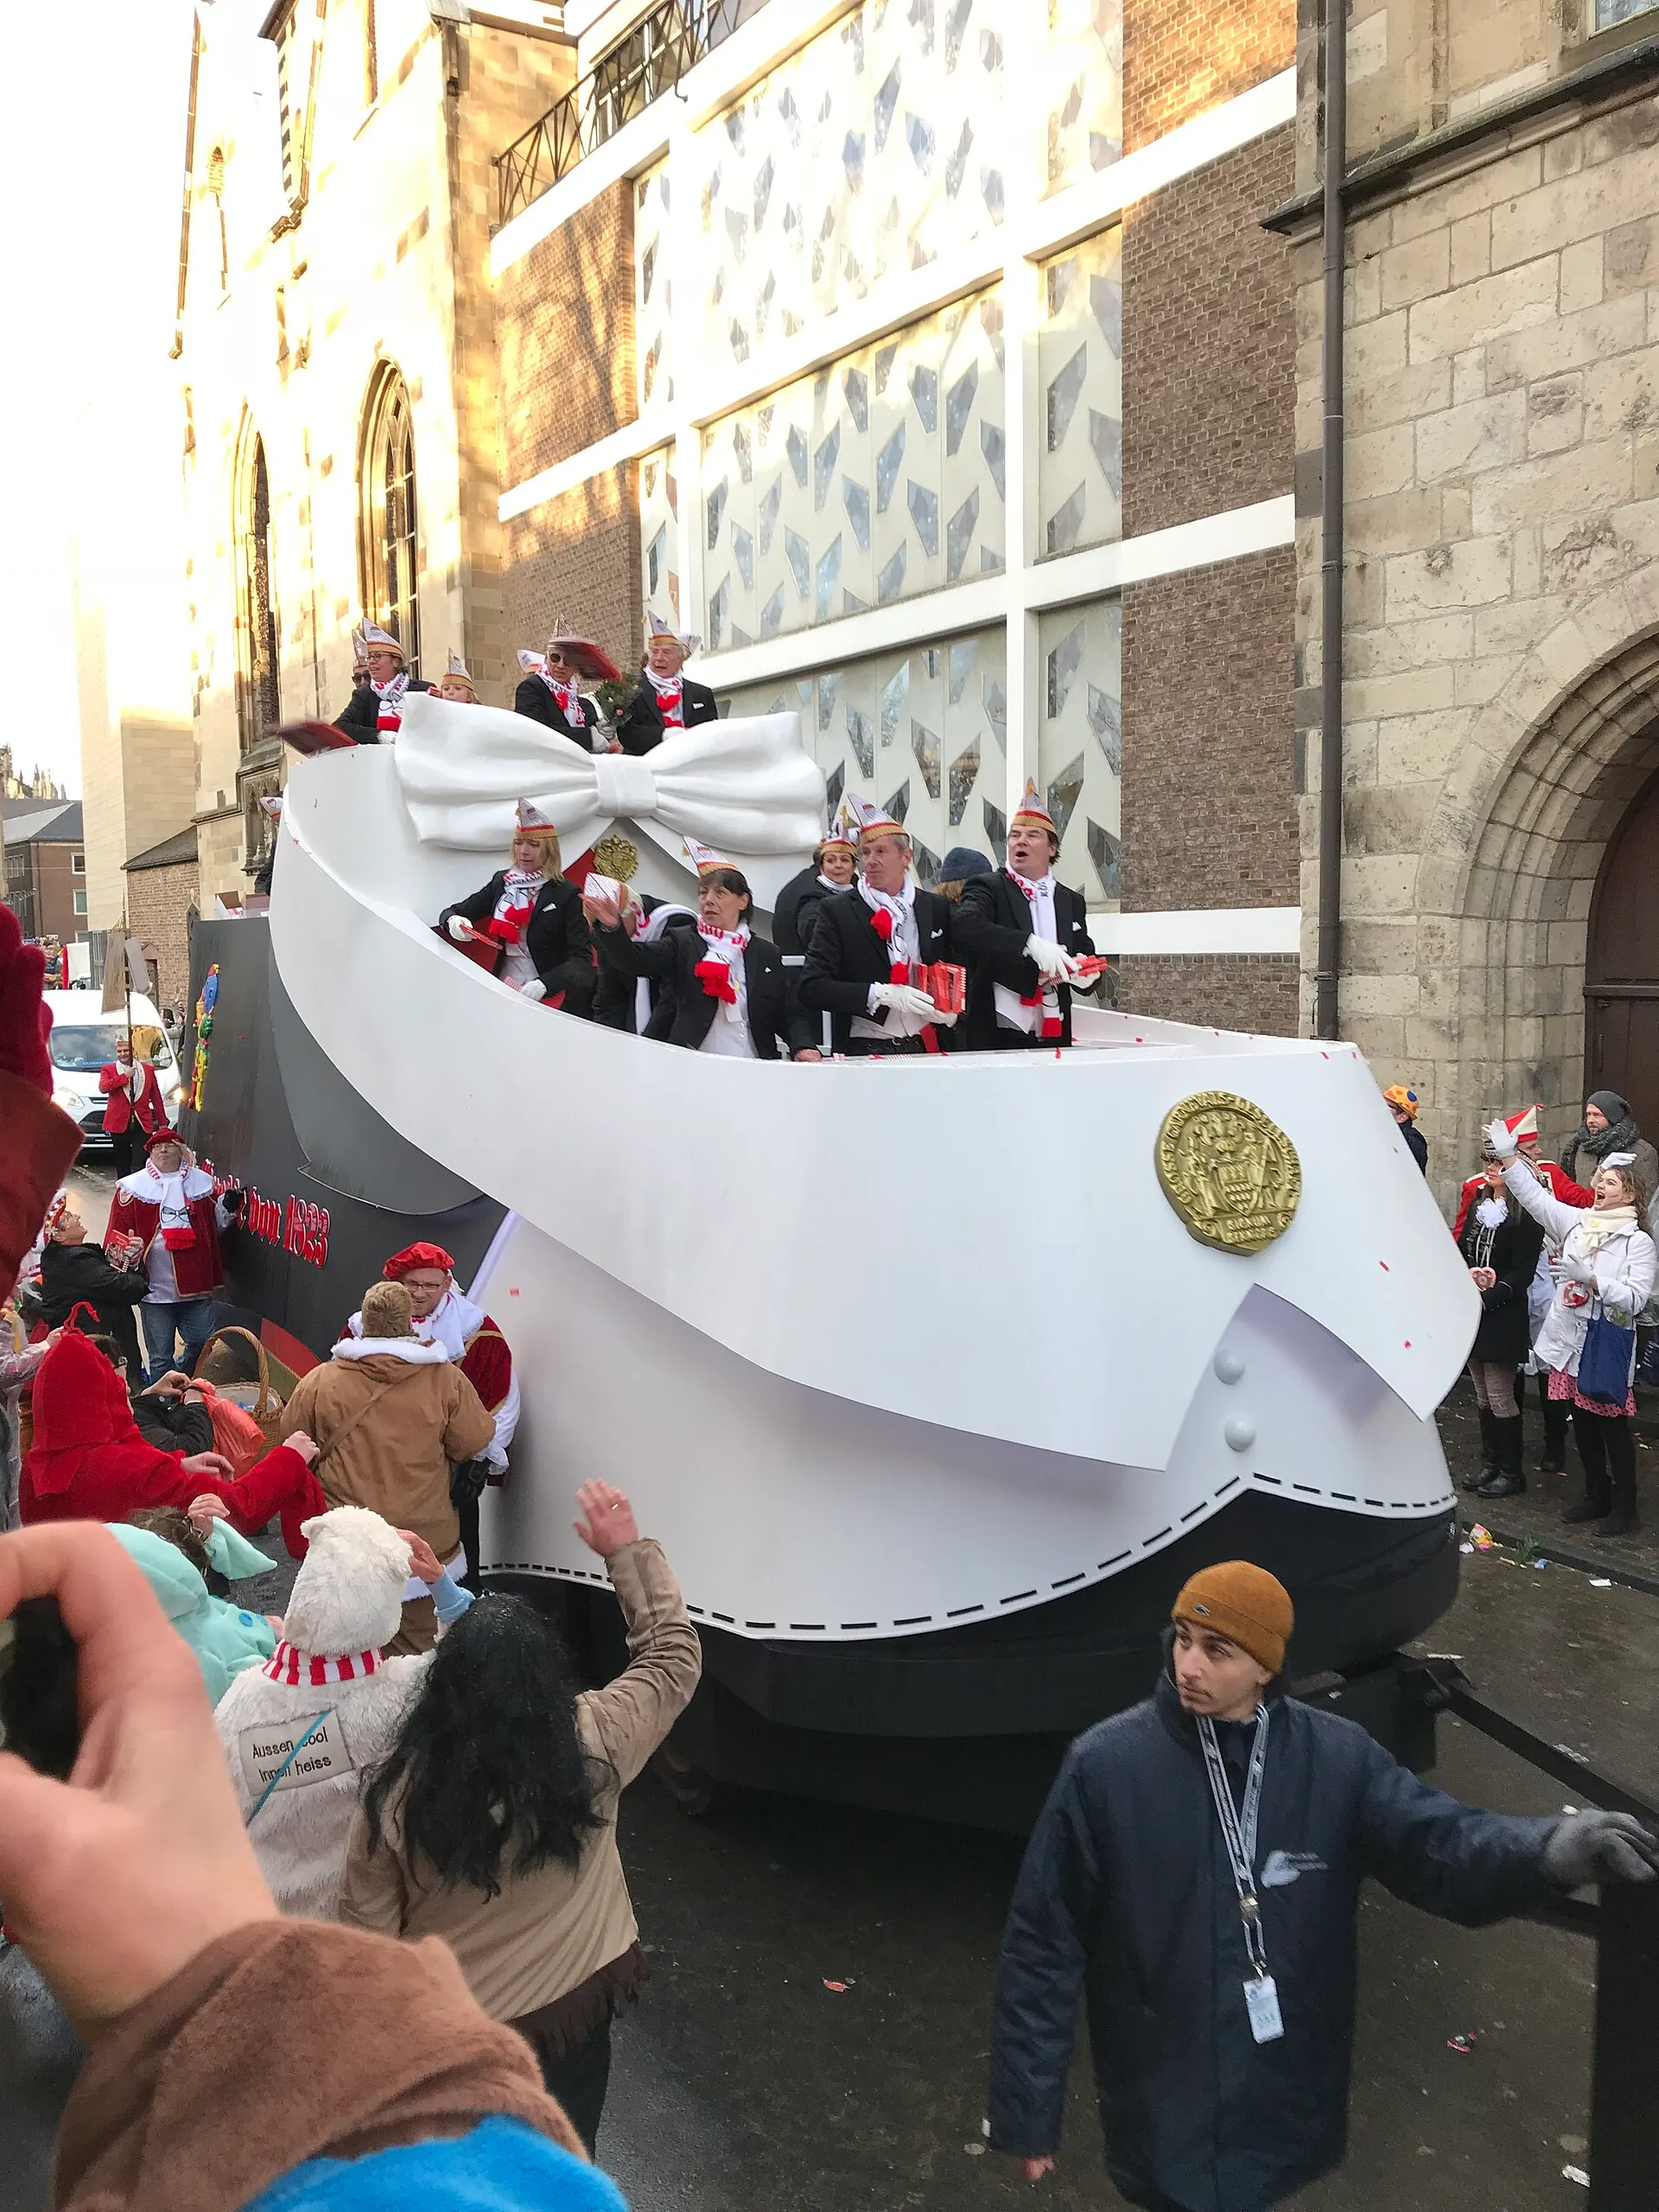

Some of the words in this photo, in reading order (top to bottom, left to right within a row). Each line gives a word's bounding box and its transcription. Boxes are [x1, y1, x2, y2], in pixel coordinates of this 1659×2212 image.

[283, 1193, 331, 1268] 1823
[252, 1739, 295, 1759] Aussen
[295, 1756, 333, 1777] heiss
